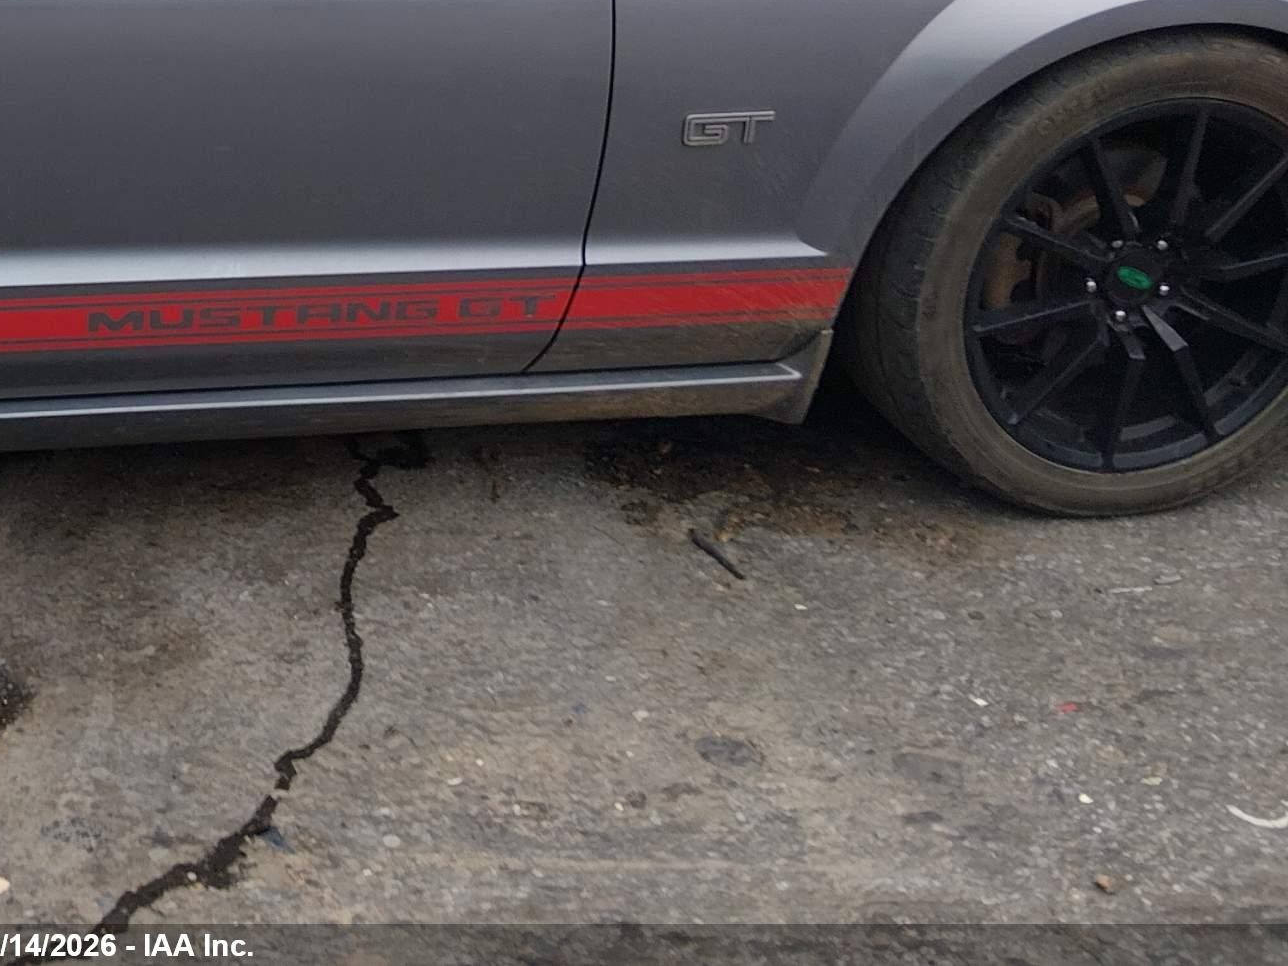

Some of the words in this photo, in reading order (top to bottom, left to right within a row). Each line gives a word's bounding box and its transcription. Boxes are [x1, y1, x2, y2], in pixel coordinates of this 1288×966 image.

[681, 110, 776, 146] GT
[88, 299, 438, 332] MUSTANG
[459, 294, 556, 318] GT
